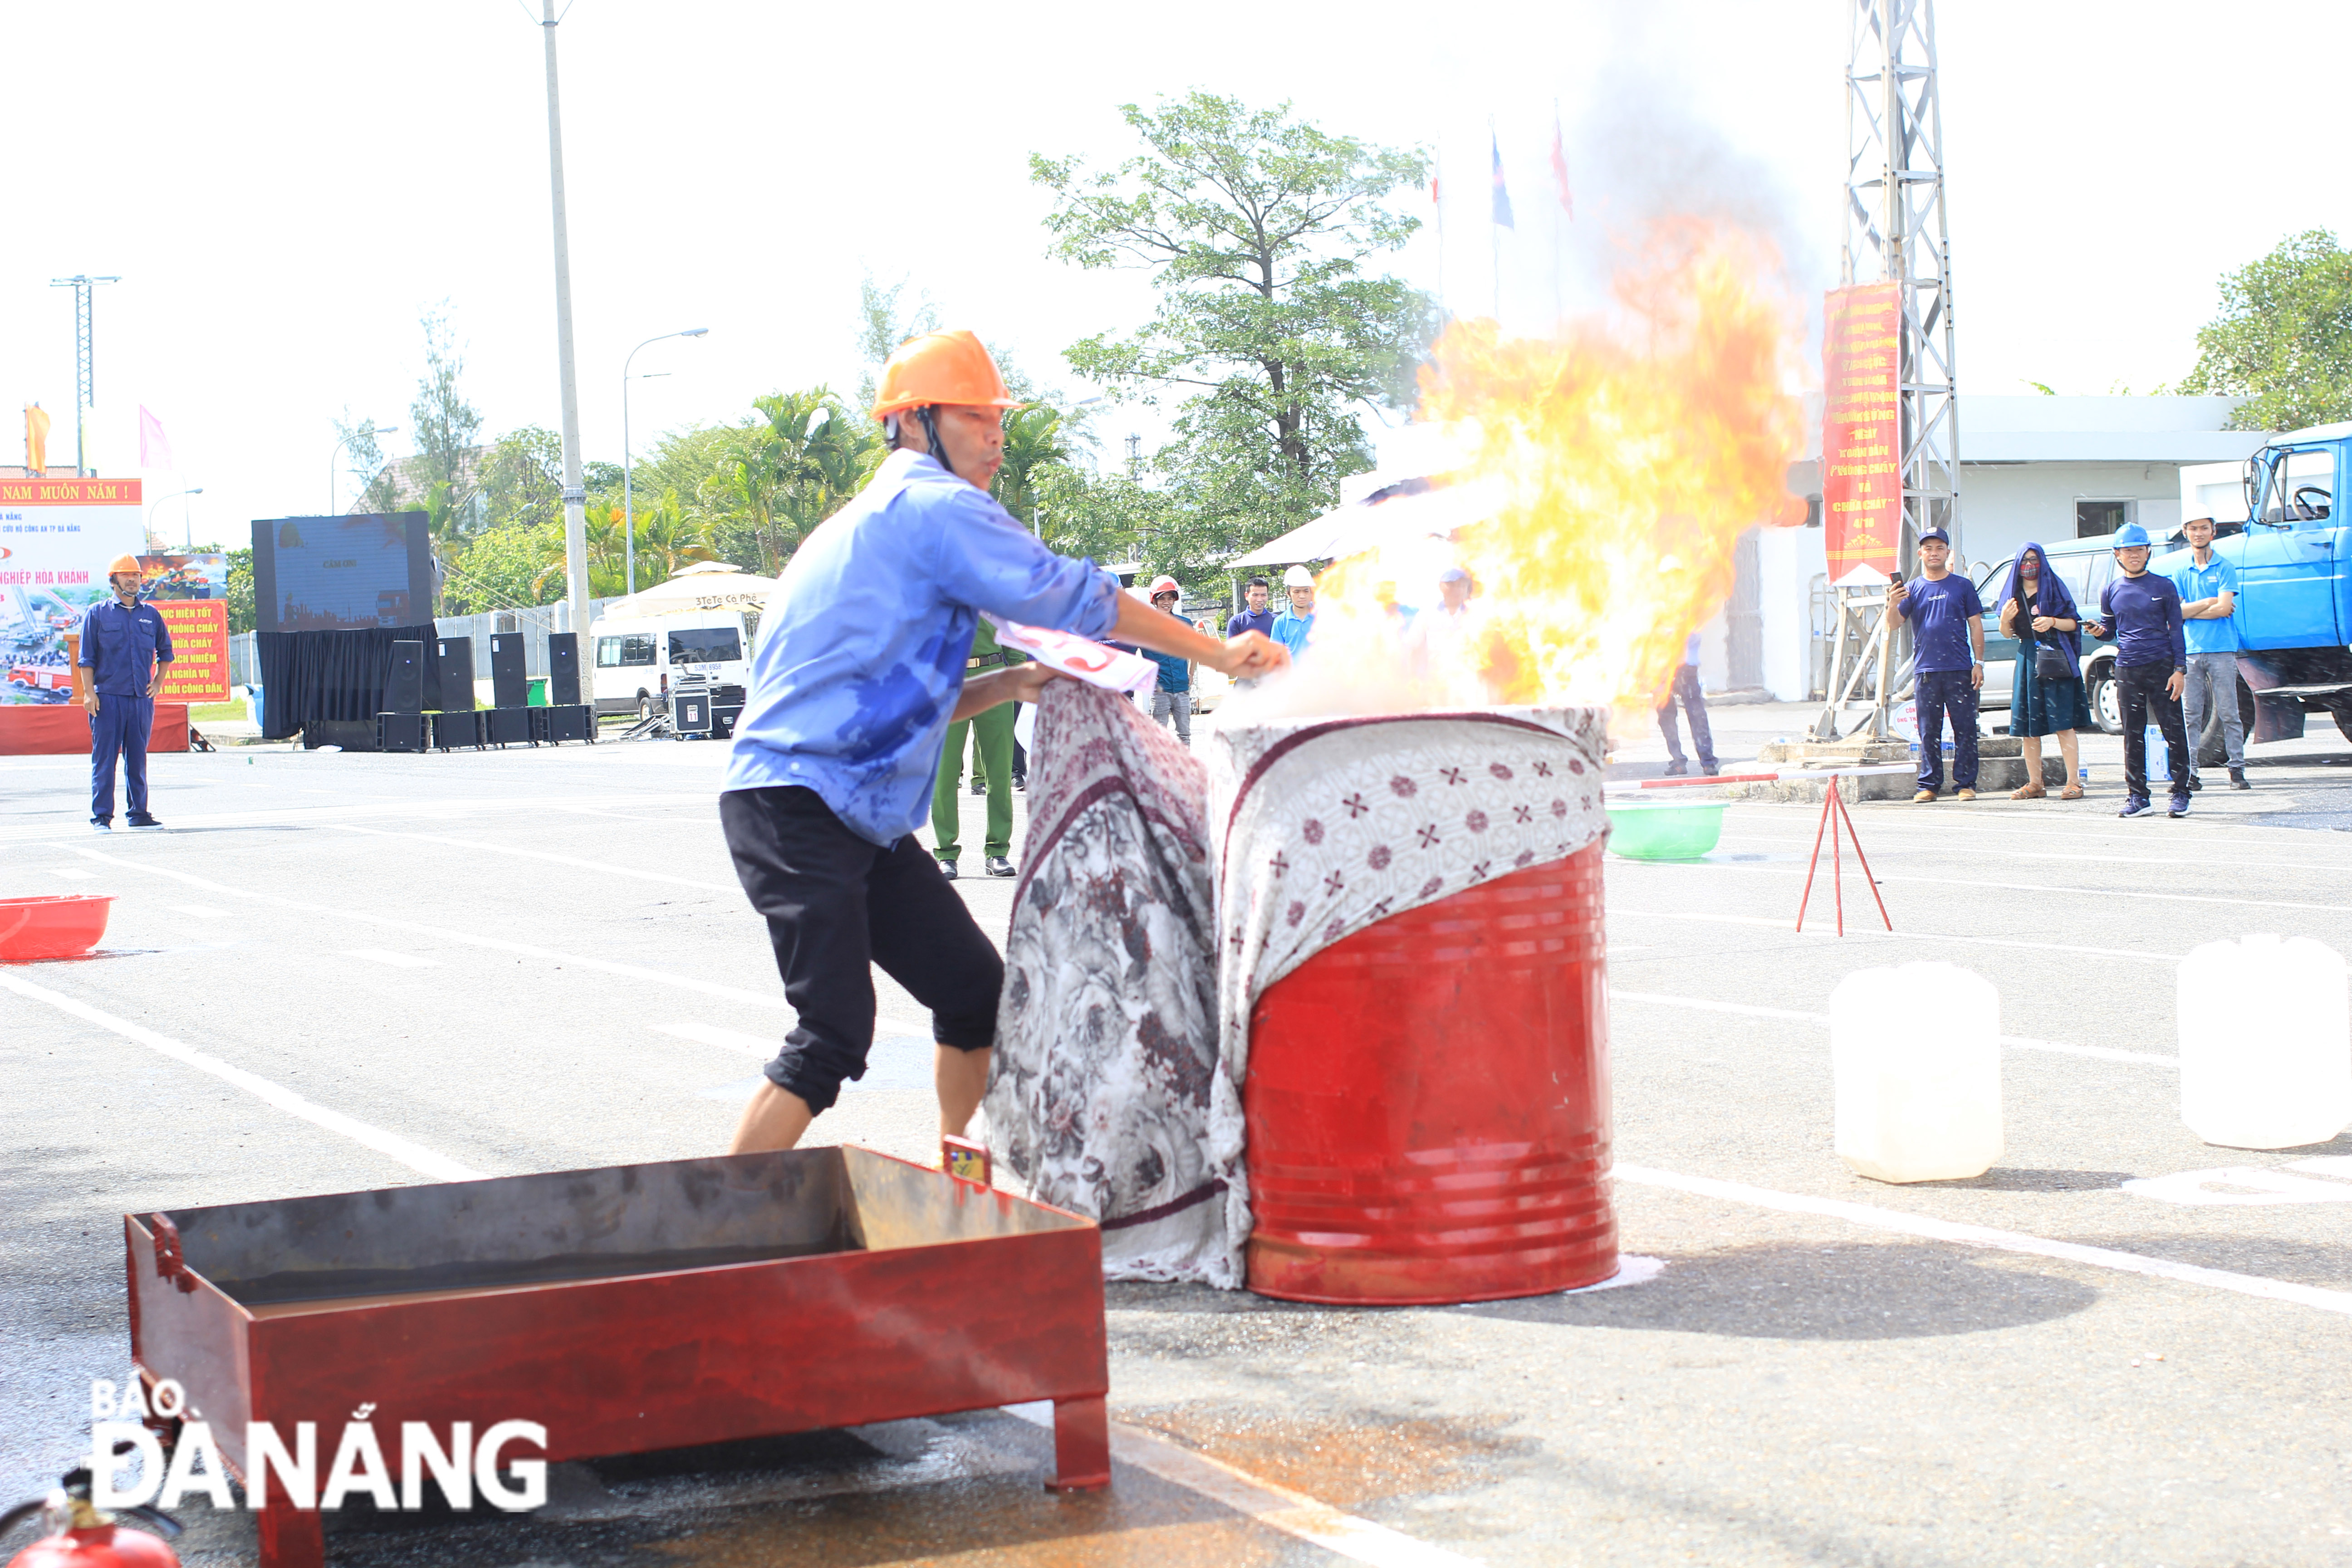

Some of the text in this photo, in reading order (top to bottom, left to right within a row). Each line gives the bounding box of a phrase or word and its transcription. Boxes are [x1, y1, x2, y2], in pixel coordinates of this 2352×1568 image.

[1868, 444, 1889, 457] DÂN
[1869, 461, 1897, 474] CHÁY
[2, 486, 32, 500] NAM
[39, 482, 79, 500] MUÔN
[87, 483, 117, 499] NĂM
[1858, 480, 1872, 493] VÀ
[1832, 499, 1862, 512] CHỮA
[25, 524, 39, 533] CÔNG
[1853, 517, 1875, 529] 4/10
[35, 568, 54, 584] HÒA
[58, 567, 89, 584] KHÁNH
[725, 594, 737, 603] Cà
[740, 593, 757, 602] Phê
[176, 607, 196, 620] HIỆN
[196, 606, 212, 618] TỐT
[167, 622, 219, 634] PHÒNG CHÁY
[172, 637, 213, 649] HỮA CHÁY
[190, 652, 217, 665] NHIỆM
[172, 667, 197, 679] NGHĨA
[199, 668, 211, 680] VỤ
[165, 682, 180, 694] MỖI
[182, 683, 204, 694] CÔNG
[206, 682, 224, 693] DÂN.
